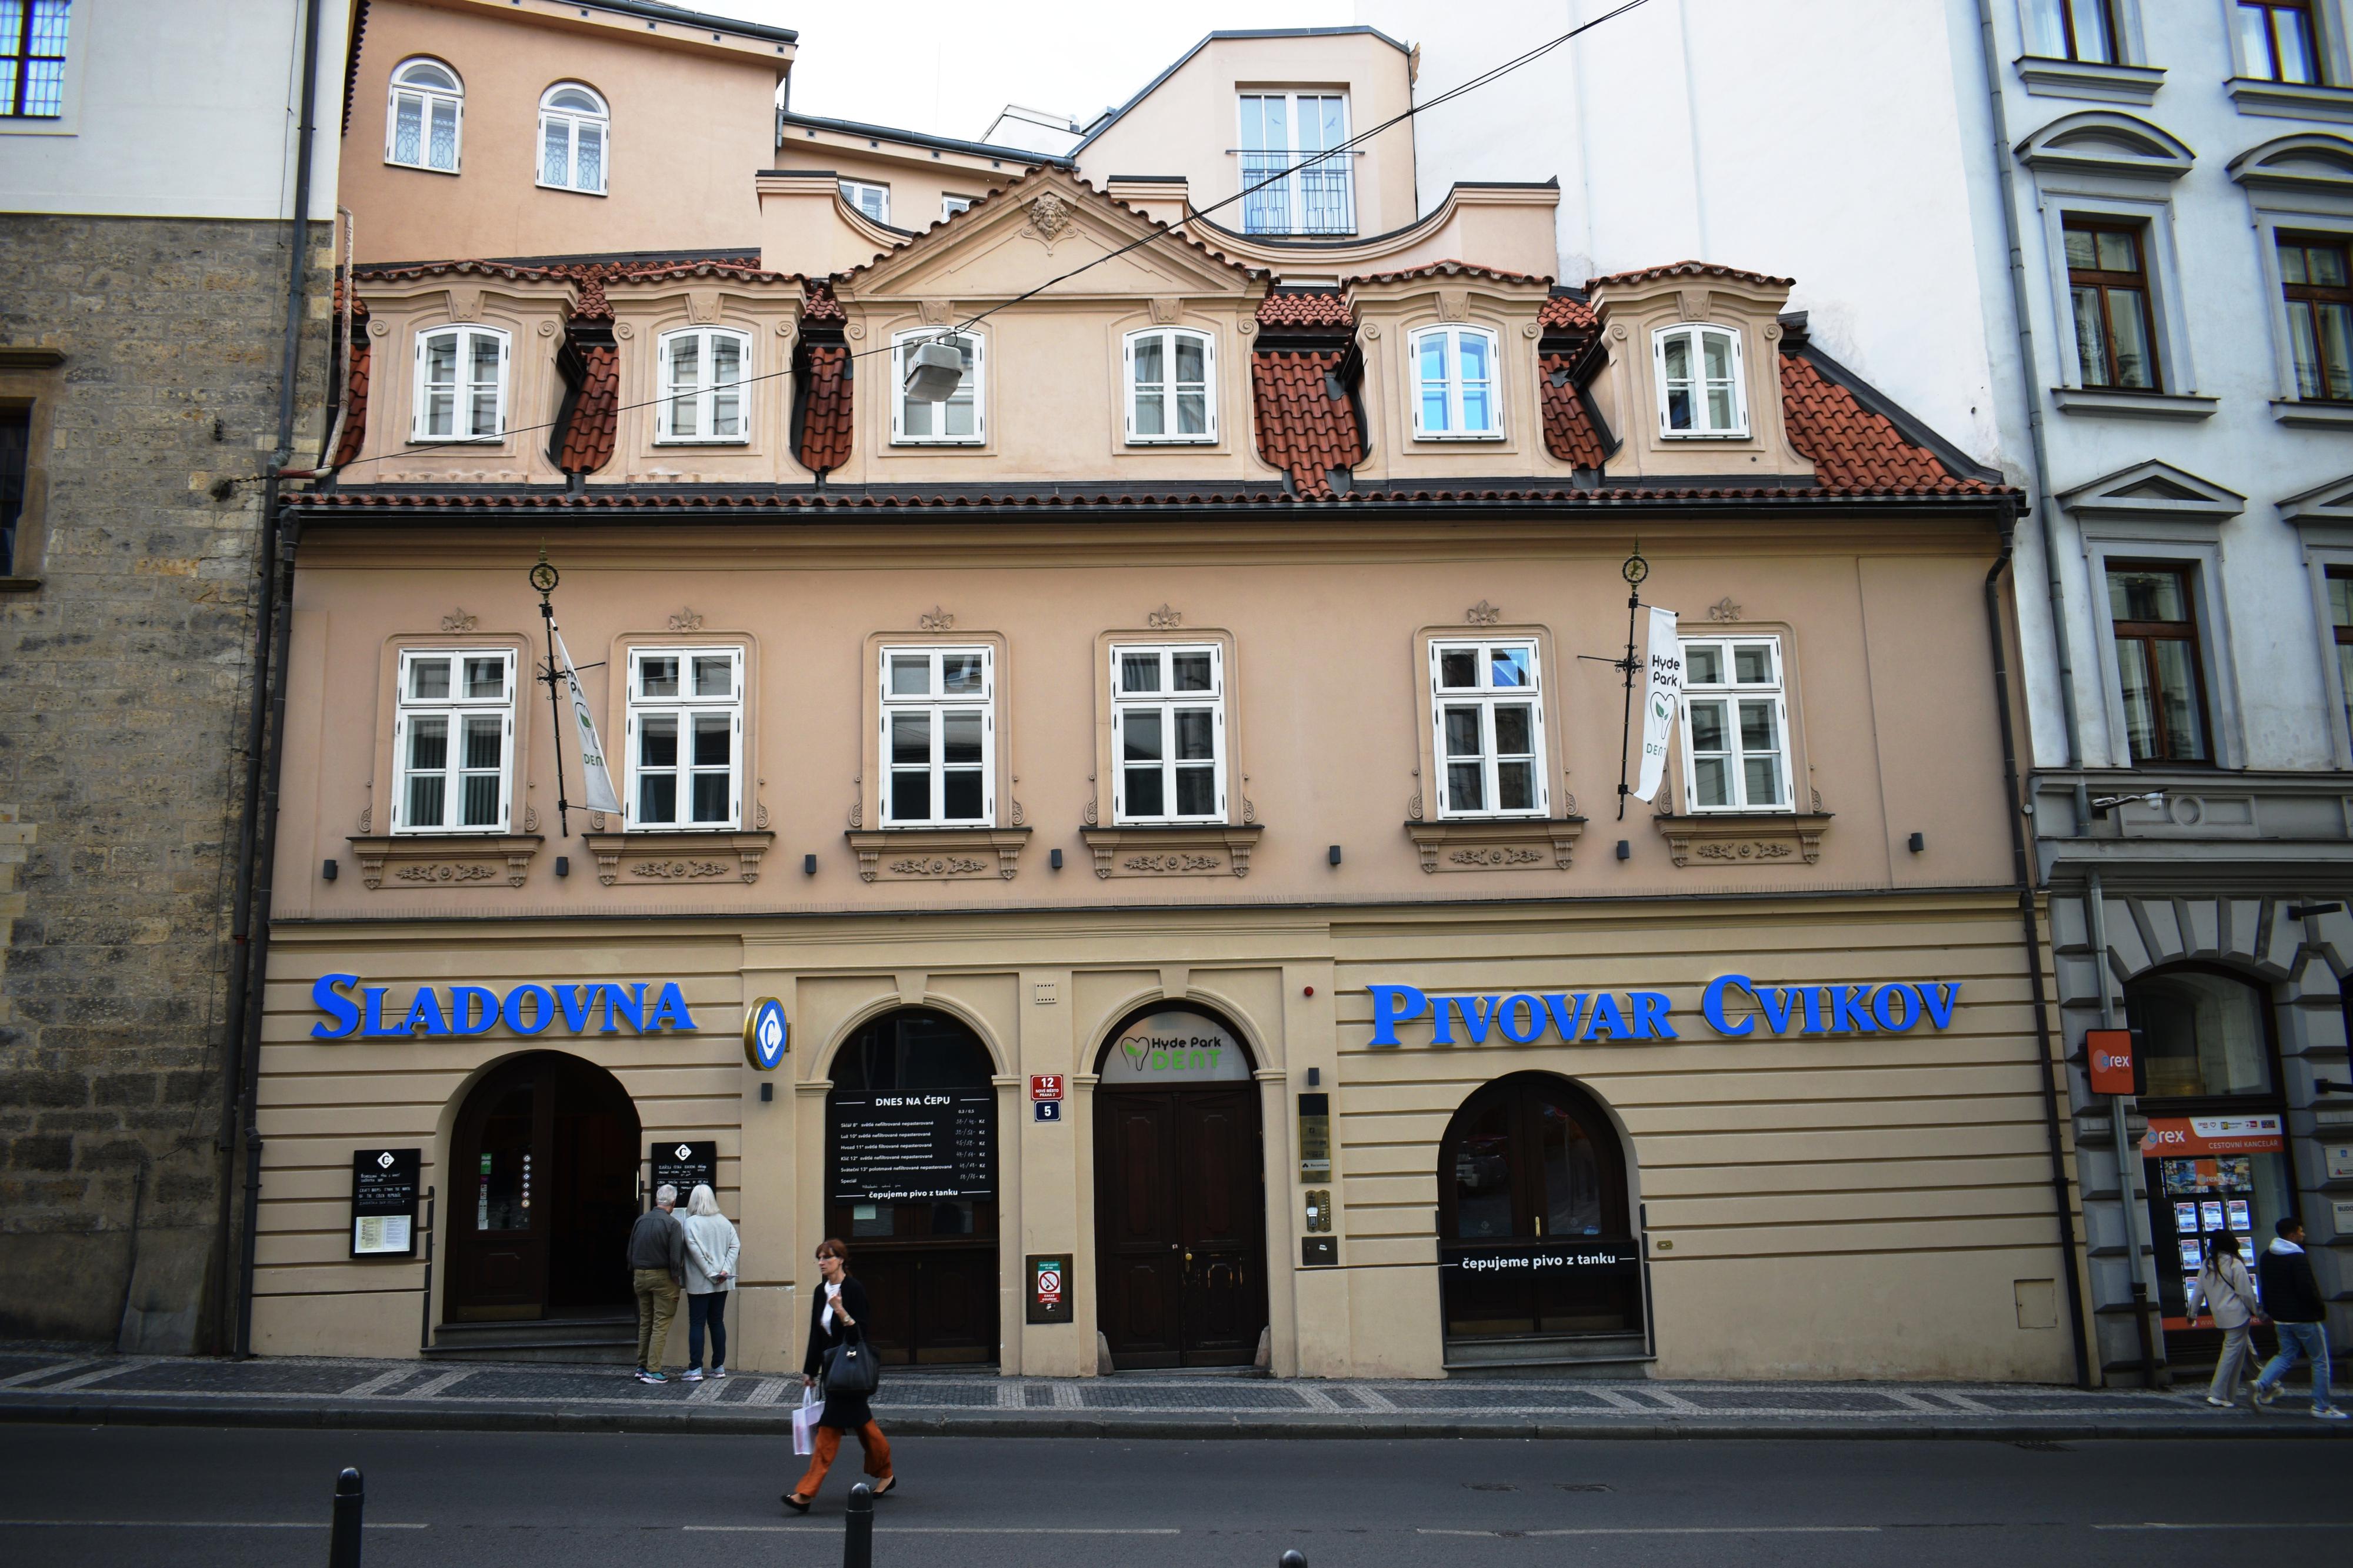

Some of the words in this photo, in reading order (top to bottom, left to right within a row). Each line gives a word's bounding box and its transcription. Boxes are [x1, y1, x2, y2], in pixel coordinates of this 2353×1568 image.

[1652, 655, 1680, 670] Hyde
[1653, 671, 1677, 687] Park
[584, 753, 603, 767] DEN
[311, 973, 698, 1039] SLADOVNA
[1366, 984, 1679, 1046] PIVOVAR
[1701, 974, 1963, 1036] CVIKOV
[1152, 1037, 1187, 1050] Hyde
[1191, 1036, 1221, 1047] Park
[1152, 1049, 1222, 1070] DENT
[1041, 1077, 1054, 1087] 12
[875, 1097, 902, 1106] DNES
[924, 1095, 950, 1105] ČEPU
[1044, 1106, 1052, 1116] 5
[869, 1190, 908, 1200] čepujeme
[909, 1190, 927, 1199] pivo
[1462, 1257, 1529, 1272] čepujeme
[1533, 1255, 1562, 1269] pivo
[1567, 1257, 1574, 1265] z
[1578, 1252, 1615, 1265] tanku
